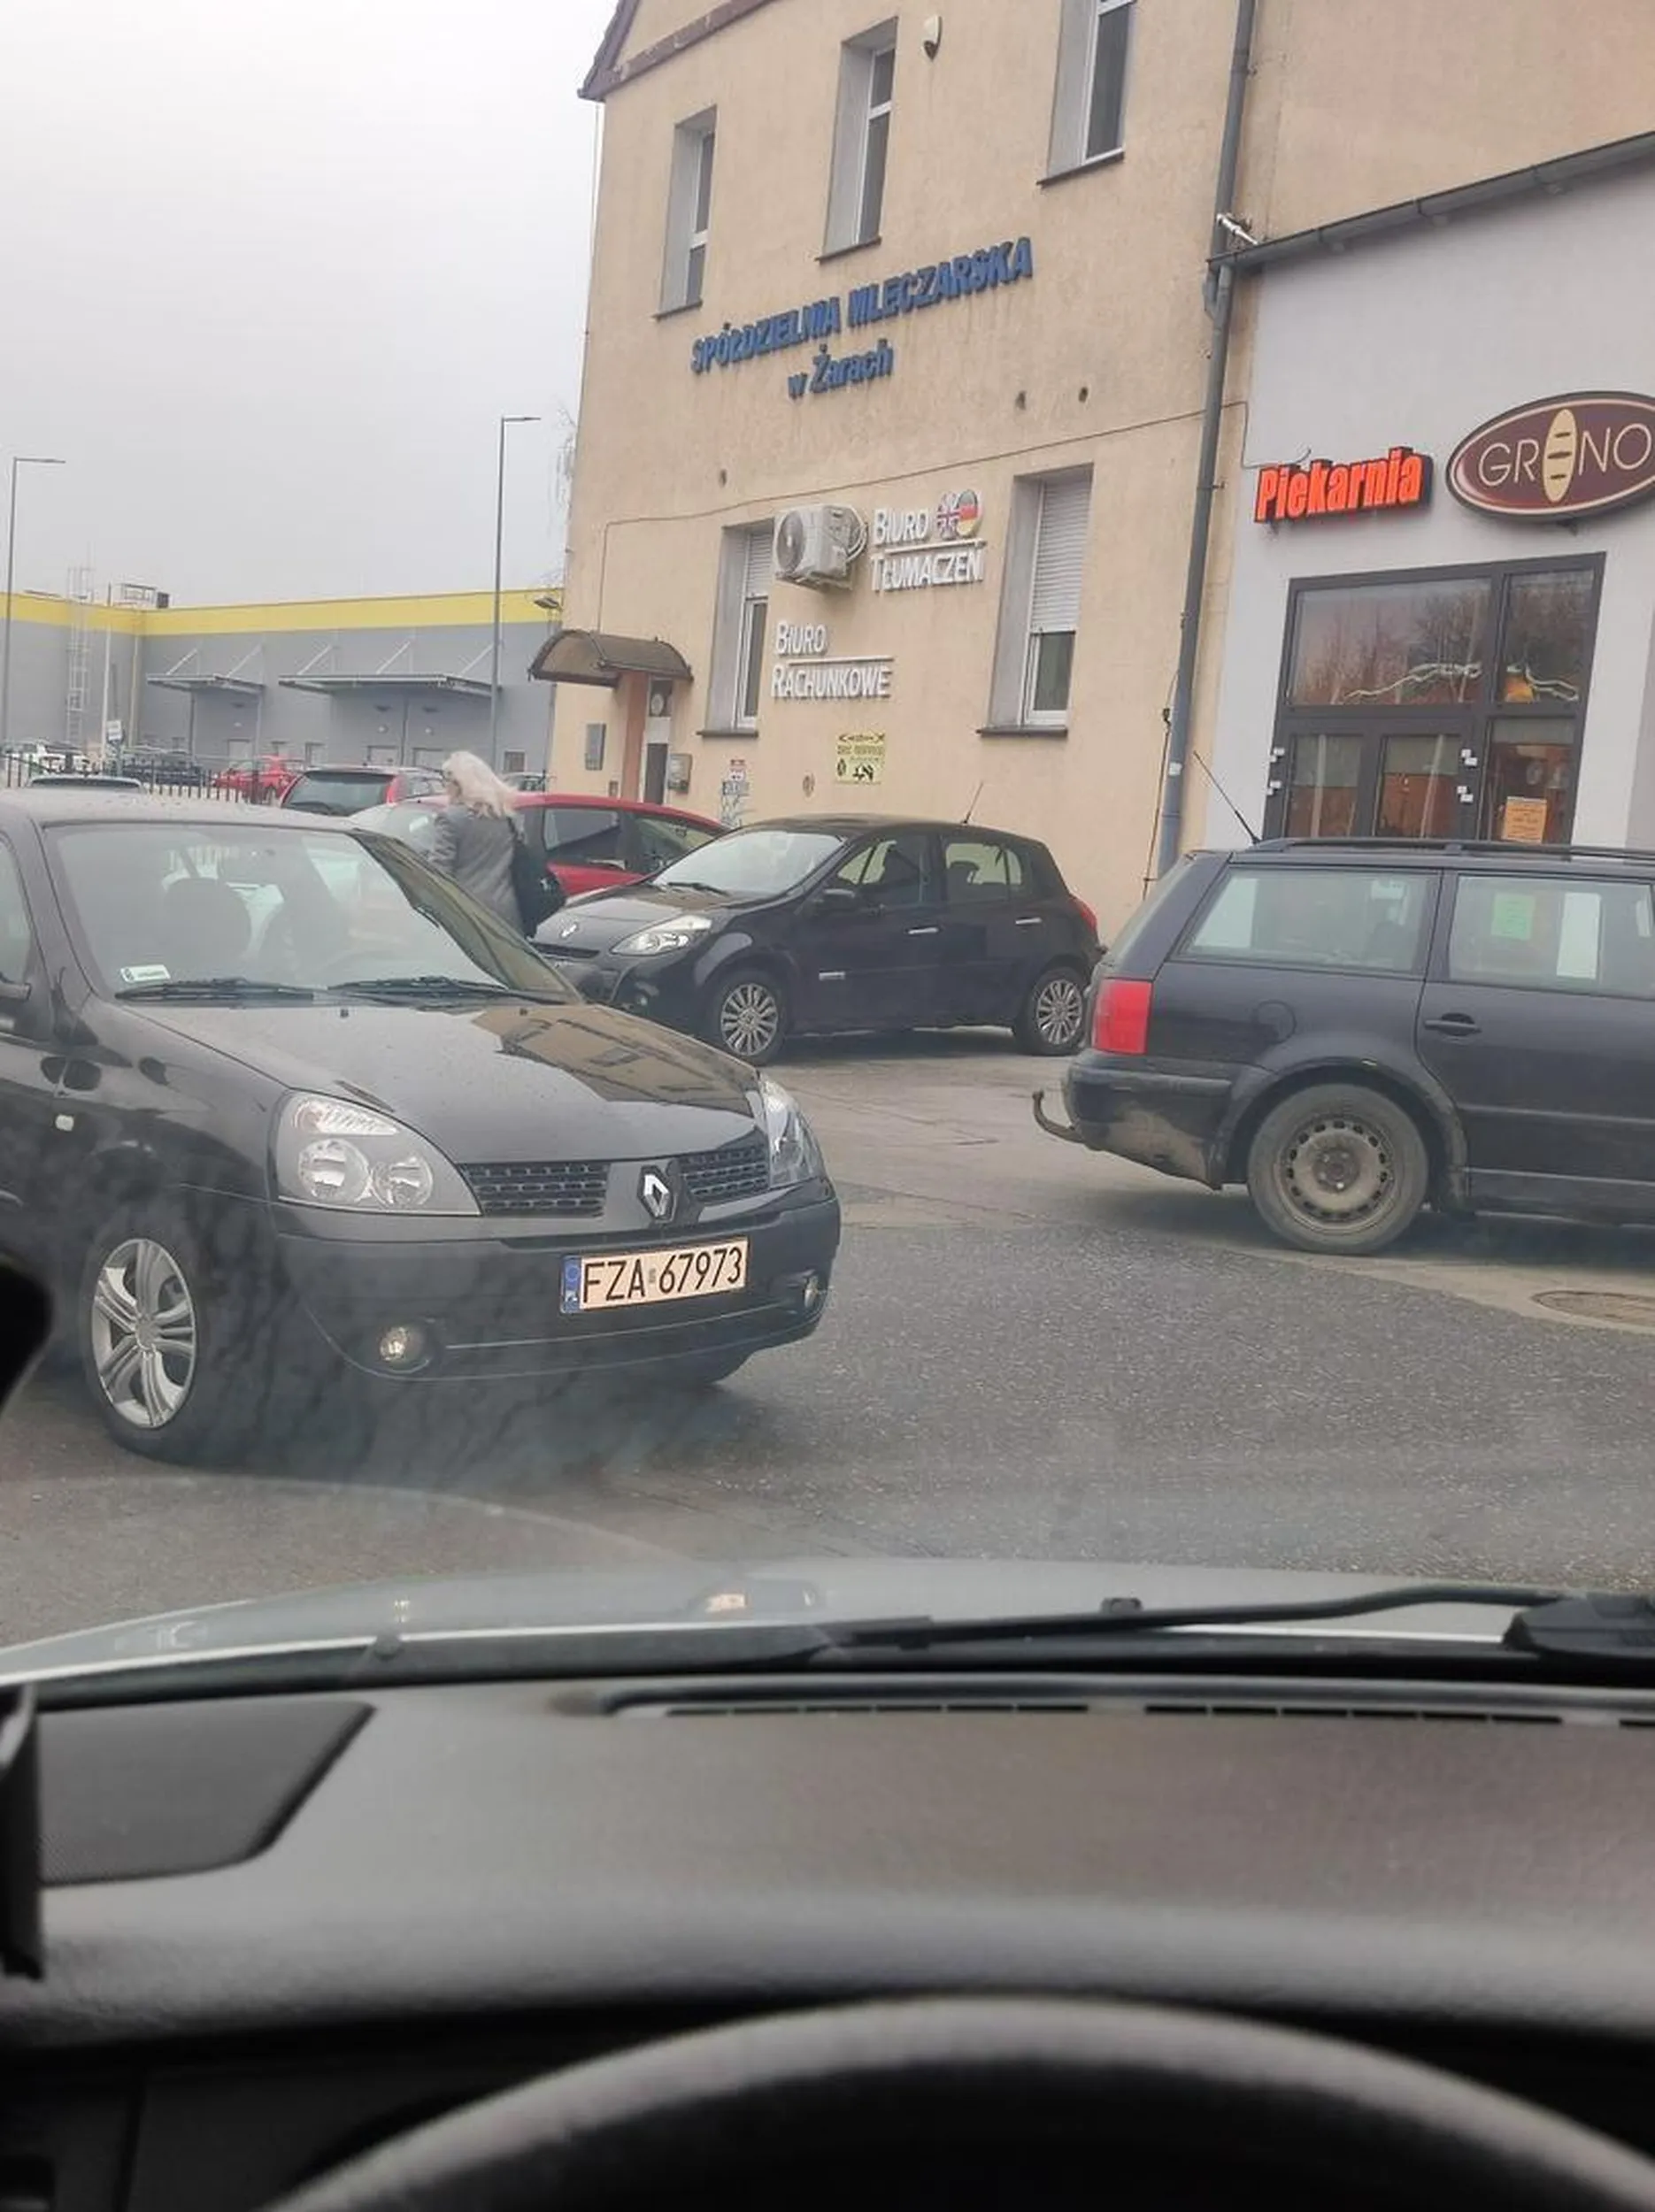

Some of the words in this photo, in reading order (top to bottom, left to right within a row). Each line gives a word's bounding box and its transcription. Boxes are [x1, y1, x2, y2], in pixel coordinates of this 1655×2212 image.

[848, 237, 1033, 327] MLECZARSKA
[788, 372, 807, 398] w
[812, 339, 895, 395] Żarach
[1255, 447, 1428, 523] Piekarnia
[583, 1259, 645, 1302] FZA
[658, 1247, 743, 1293] 67973
